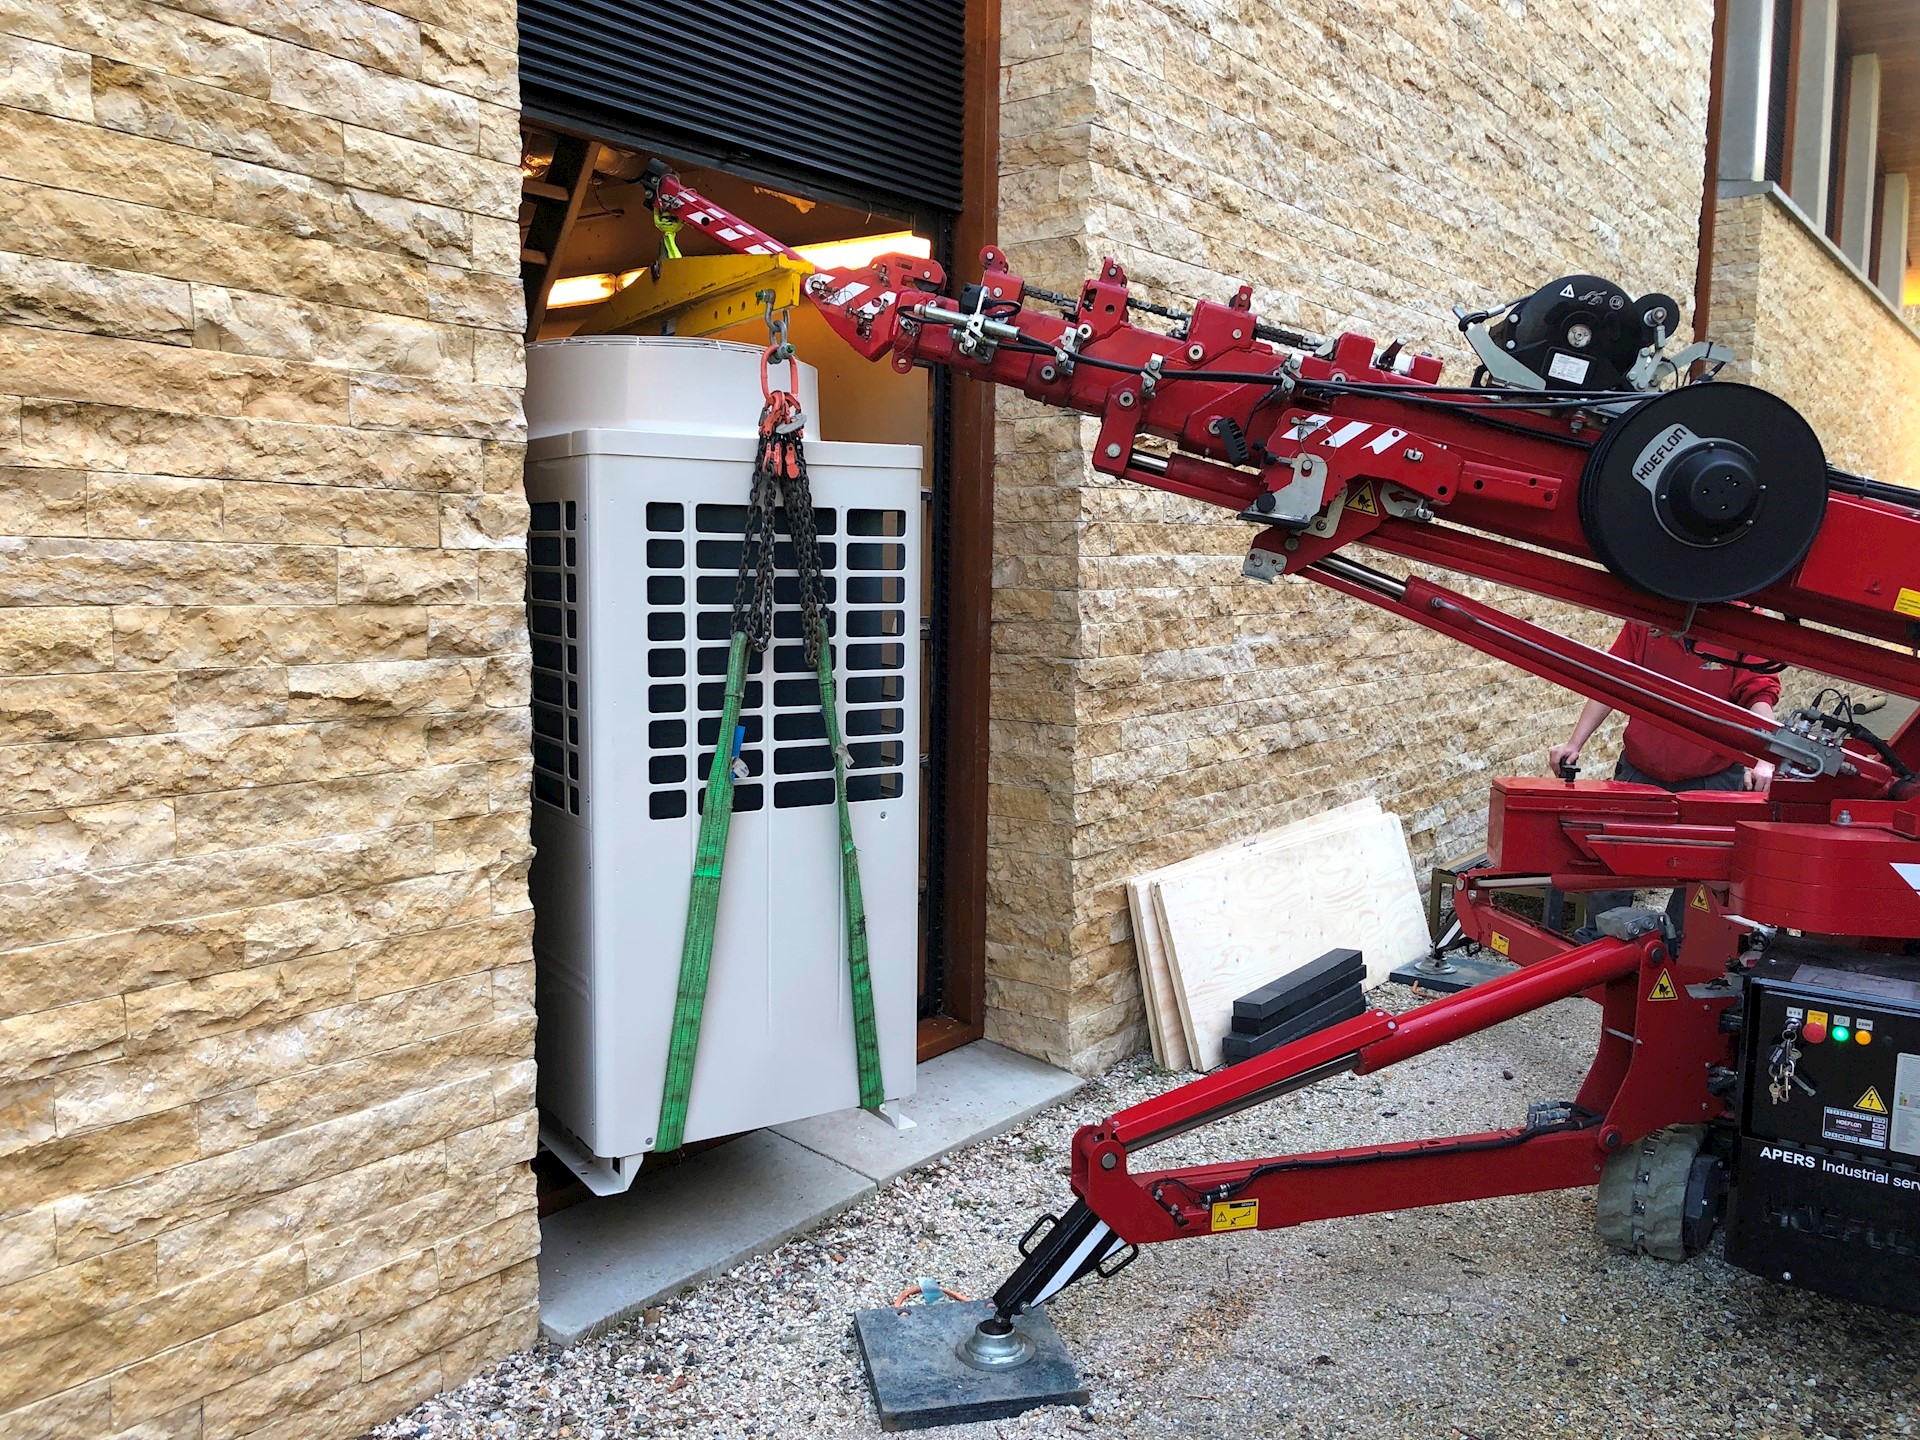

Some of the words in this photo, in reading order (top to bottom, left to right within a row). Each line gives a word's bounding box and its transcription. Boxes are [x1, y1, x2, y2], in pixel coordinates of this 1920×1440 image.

[1636, 428, 1687, 480] HOEFLON
[1760, 1147, 1816, 1169] APERS
[1822, 1159, 1889, 1185] Industrial
